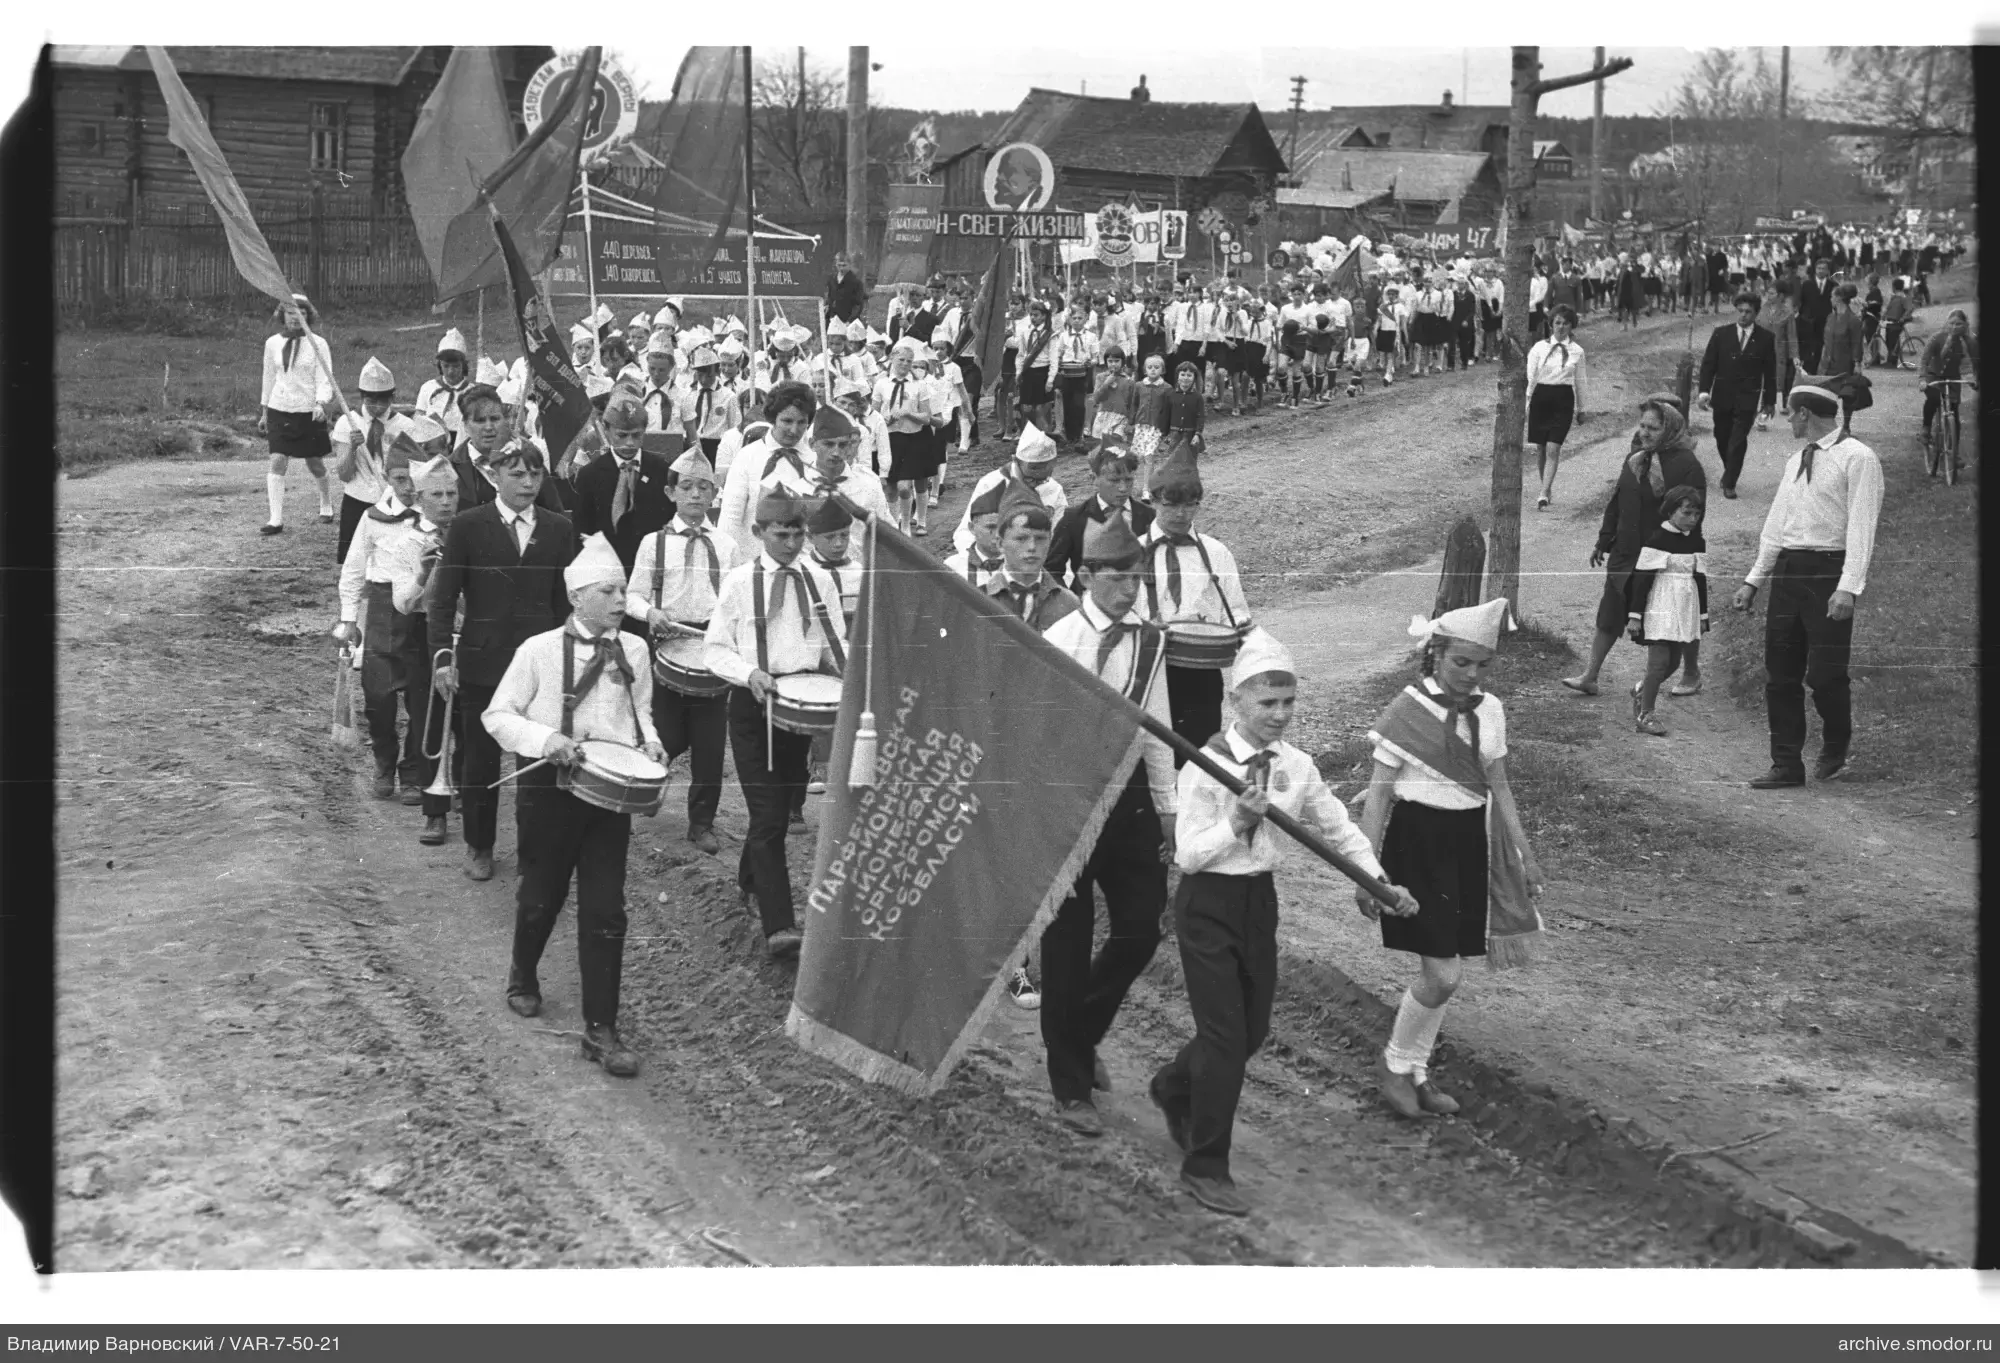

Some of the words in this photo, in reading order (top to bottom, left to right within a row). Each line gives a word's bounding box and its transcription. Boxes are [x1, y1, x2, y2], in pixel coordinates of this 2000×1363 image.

[1012, 214, 1083, 237] ЖИЗНИ
[1467, 227, 1492, 248] 47
[602, 240, 620, 259] 440
[870, 740, 984, 942] КОСТРОМСКОЙ
[907, 792, 981, 907] ОБЛАСТИ
